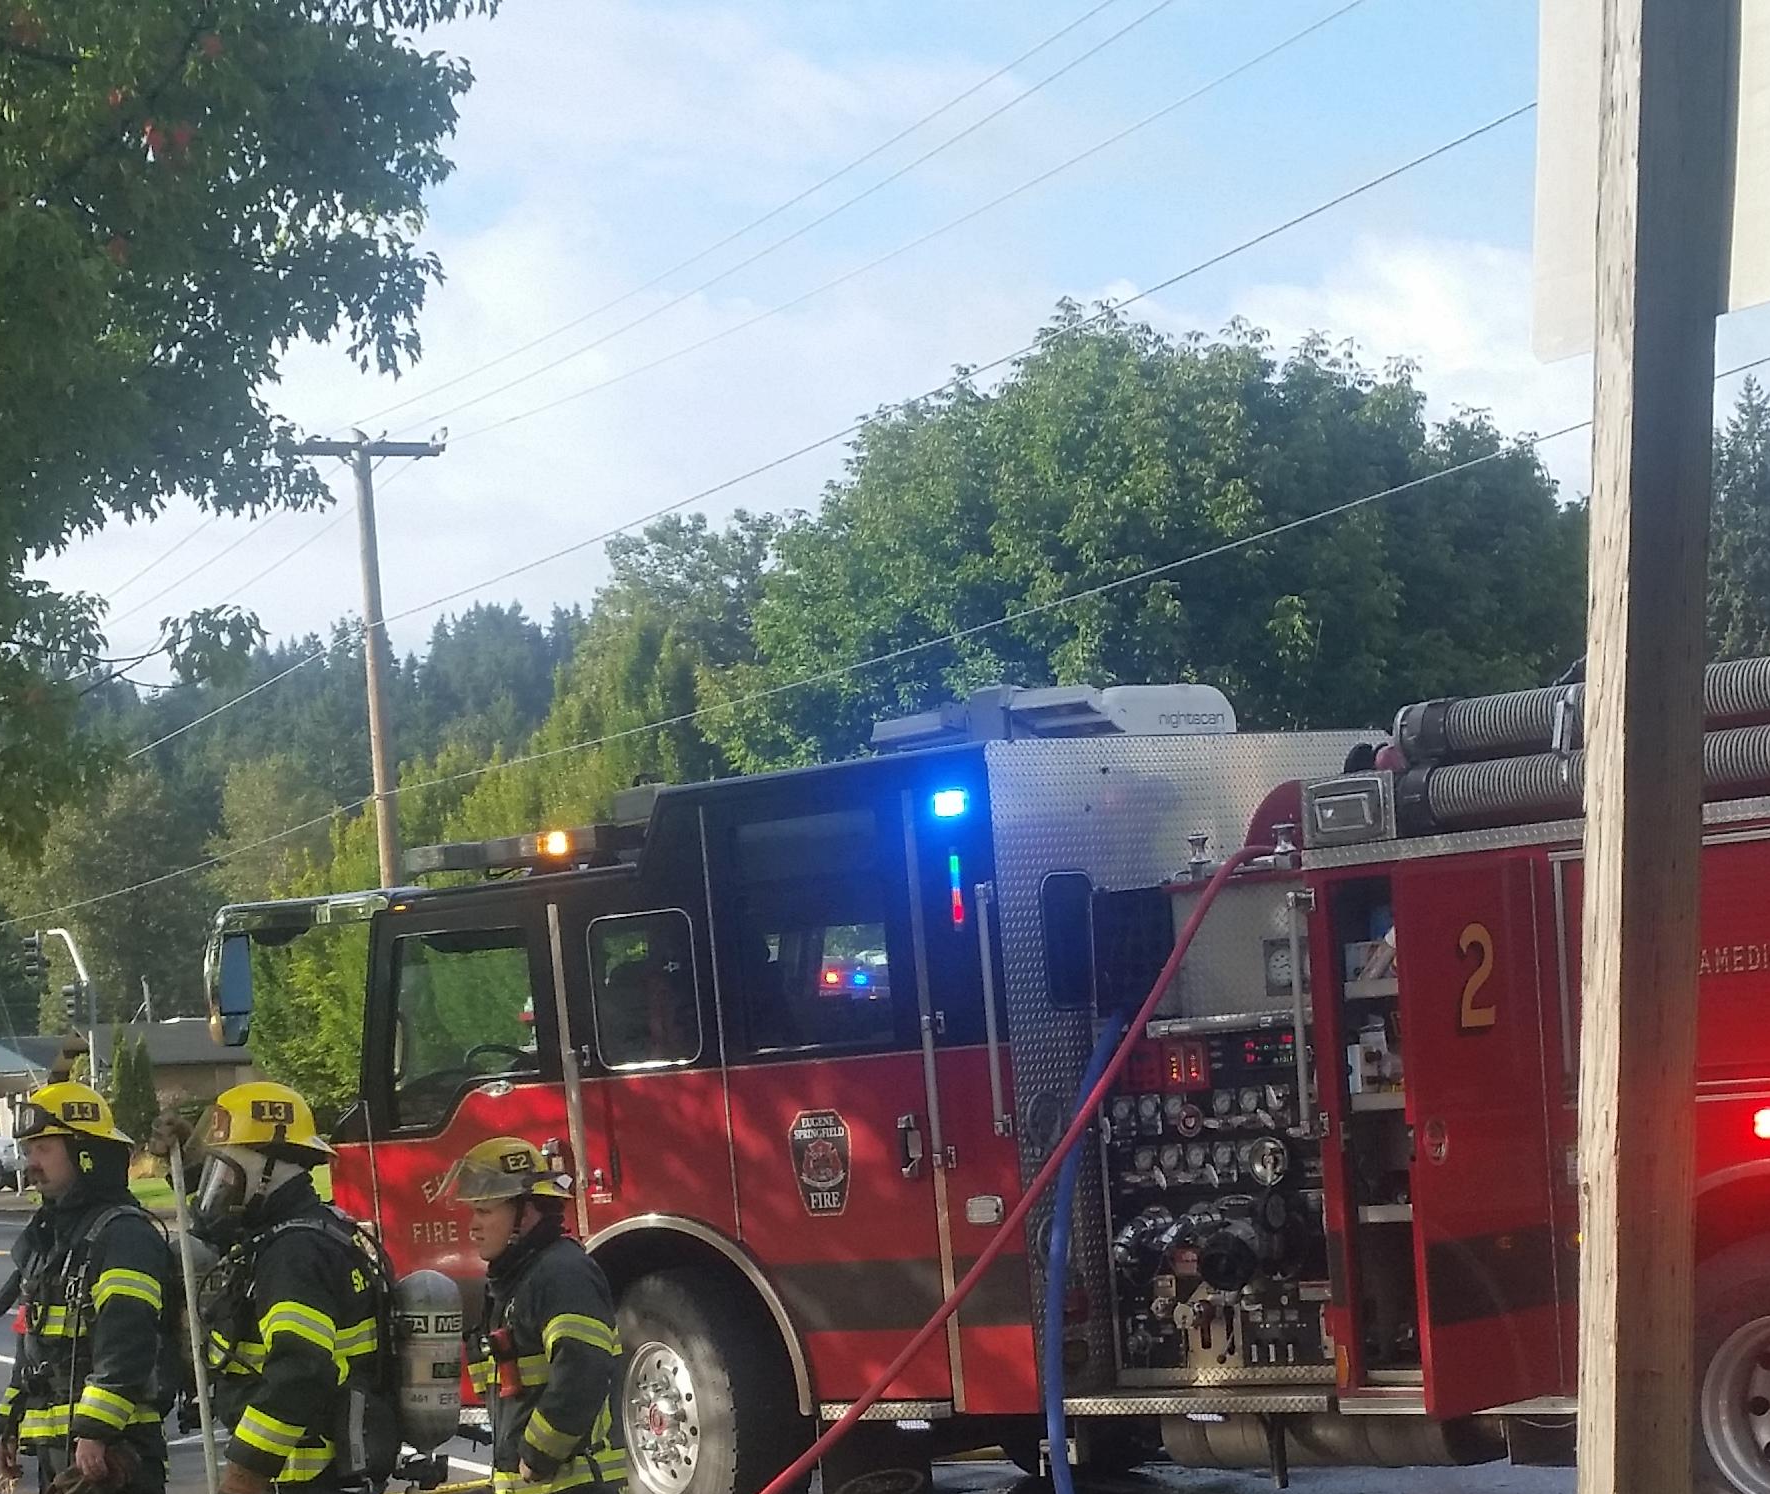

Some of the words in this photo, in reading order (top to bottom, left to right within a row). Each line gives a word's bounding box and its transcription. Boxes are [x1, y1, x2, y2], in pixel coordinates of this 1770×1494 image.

[1458, 922, 1497, 1029] 2
[70, 1103, 93, 1119] 13
[260, 1102, 285, 1120] 13
[801, 1116, 835, 1128] EUGENE
[793, 1127, 845, 1140] SPRINGFIELD
[507, 1154, 530, 1171] E2
[809, 1191, 841, 1209] FIRE
[412, 1221, 459, 1243] FIRE
[437, 1317, 462, 1332] MS
